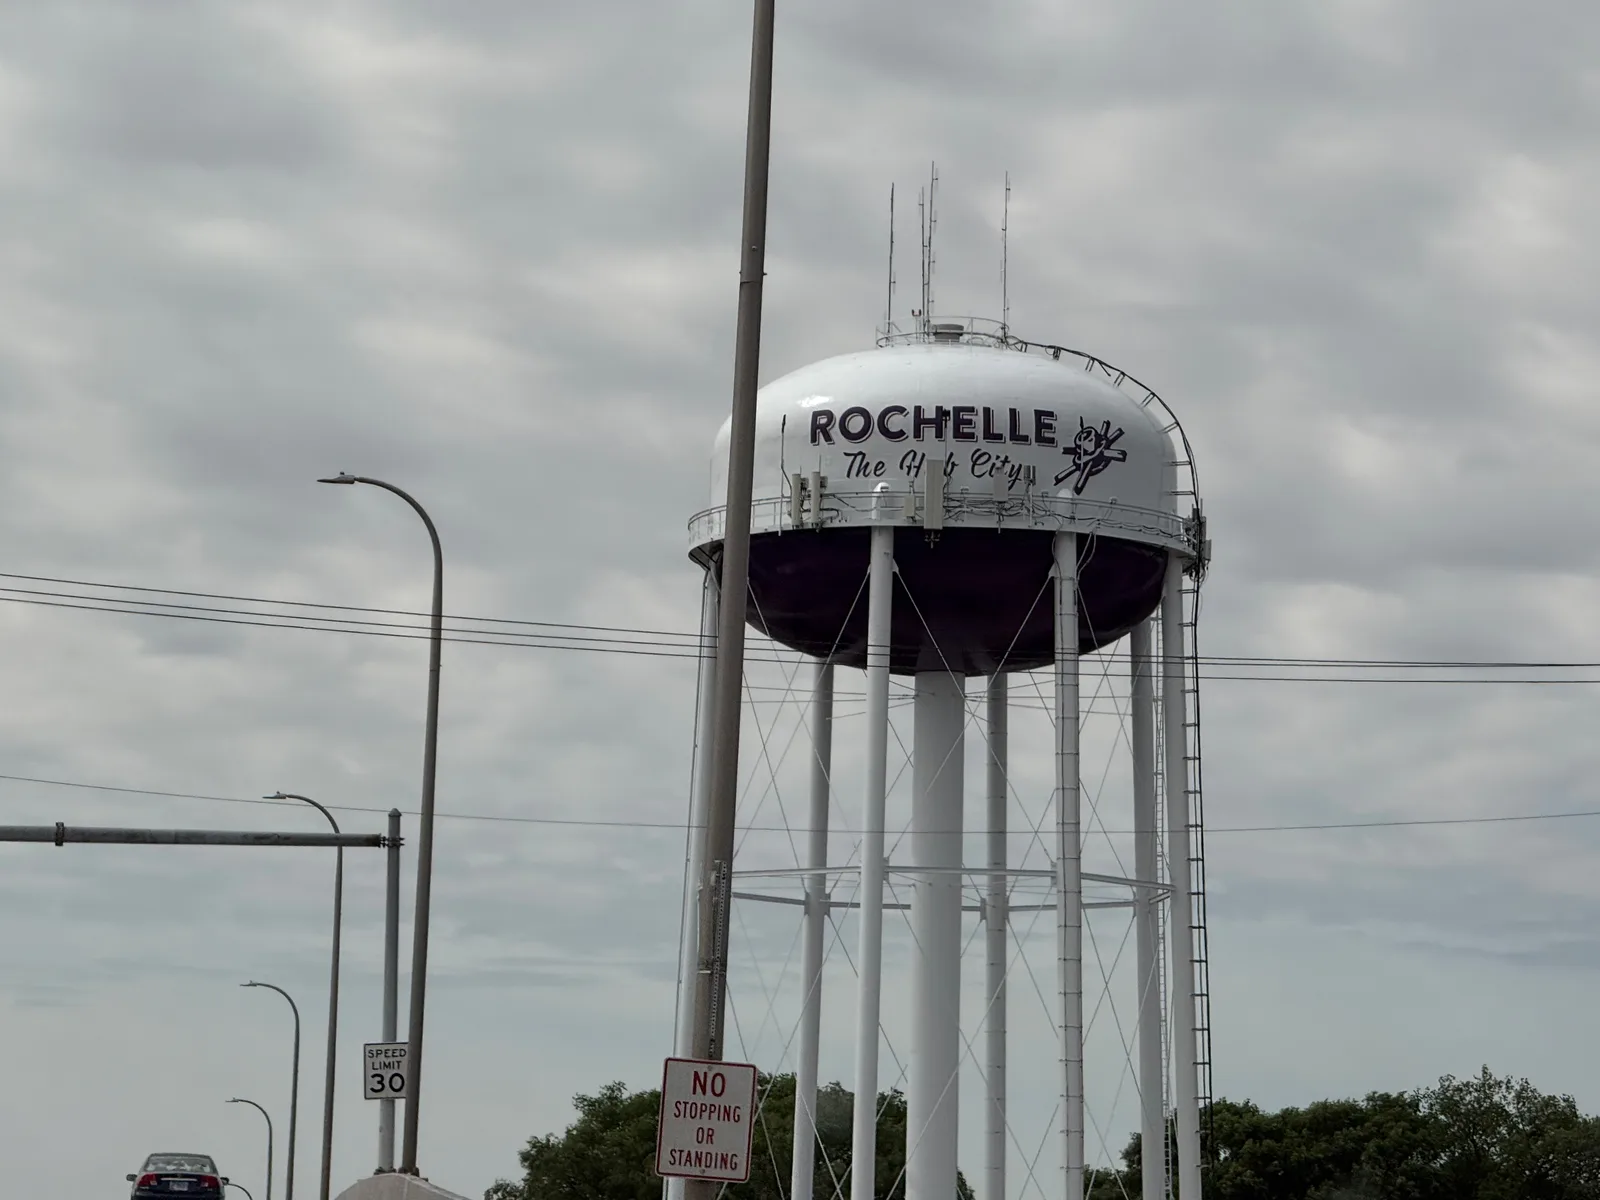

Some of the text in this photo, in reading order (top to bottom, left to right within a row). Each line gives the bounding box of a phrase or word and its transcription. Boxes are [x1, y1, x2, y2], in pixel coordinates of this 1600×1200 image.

[810, 405, 1057, 448] ROCHELLE
[843, 451, 887, 478] The
[899, 449, 959, 478] Hb
[368, 1048, 407, 1058] SPEED
[372, 1060, 402, 1070] LIMIT
[370, 1072, 405, 1093] 30
[692, 1071, 726, 1097] NO
[673, 1101, 741, 1123] STOPPING
[696, 1127, 715, 1144] OR
[669, 1149, 738, 1170] STANDING
